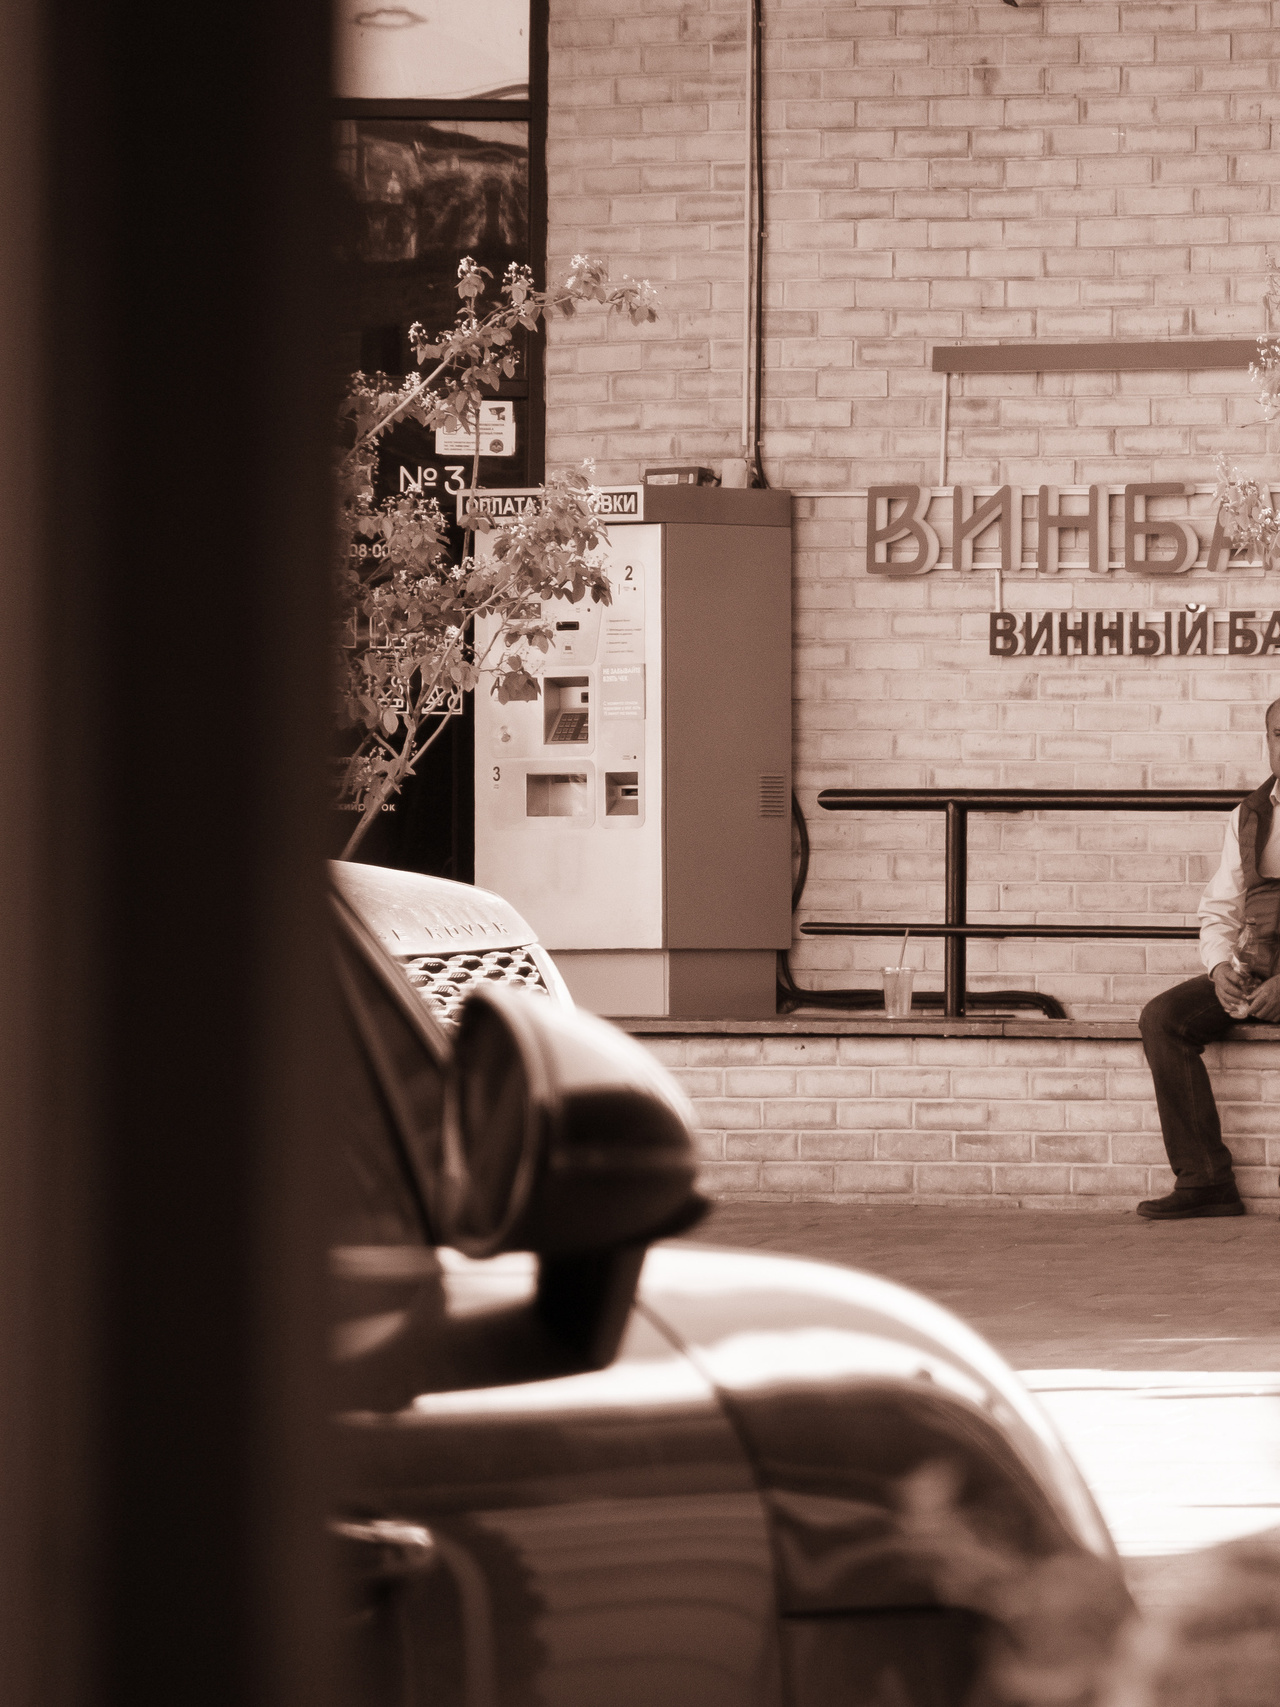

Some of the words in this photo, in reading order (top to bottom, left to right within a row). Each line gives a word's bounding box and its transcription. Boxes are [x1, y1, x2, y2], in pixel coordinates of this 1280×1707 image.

[465, 496, 537, 516] ОПЛАТА
[624, 565, 633, 581] 2
[989, 603, 1215, 656] ВИННЫЙ
[492, 766, 501, 782] 3
